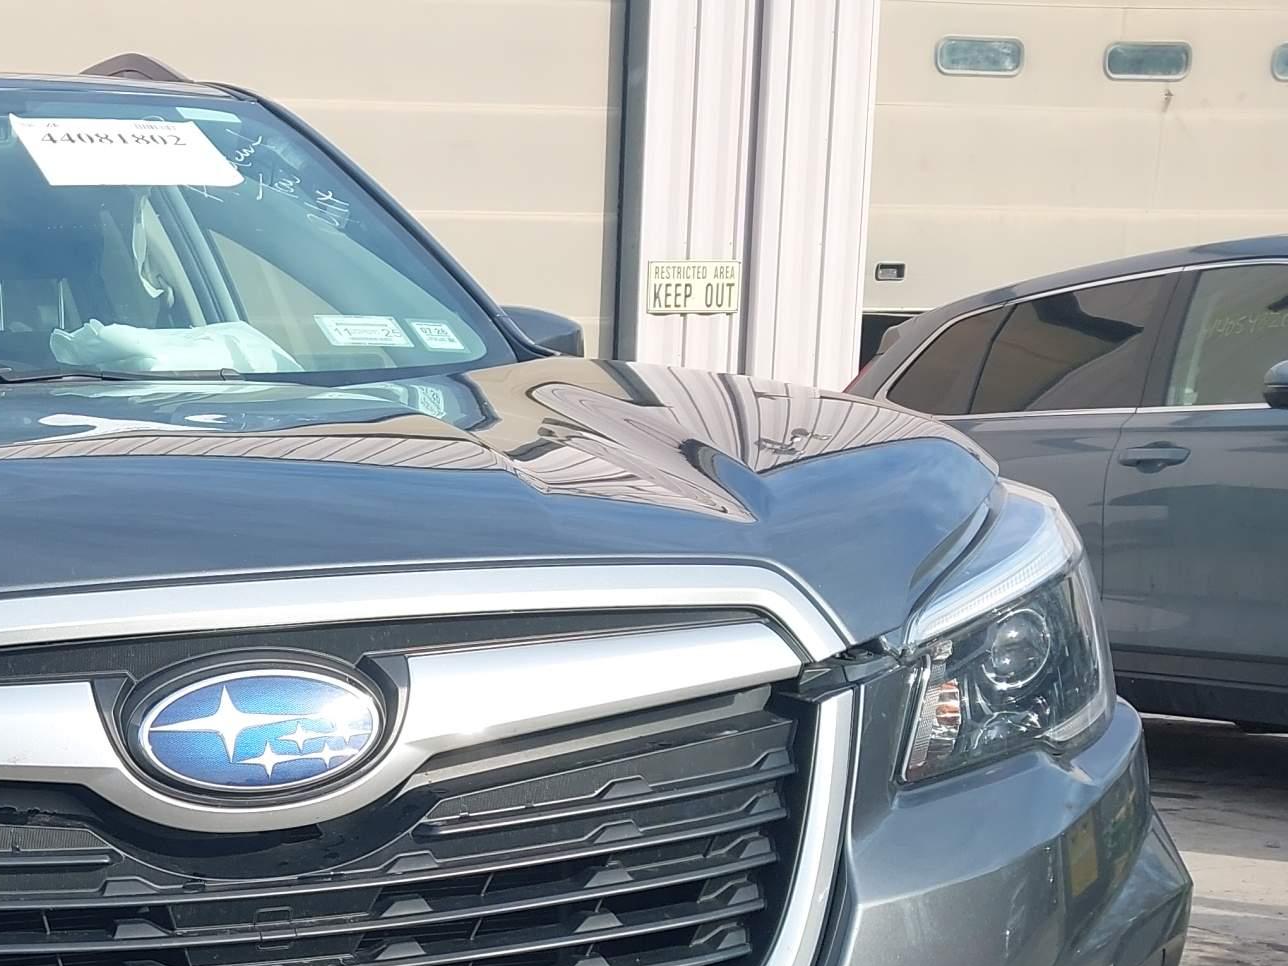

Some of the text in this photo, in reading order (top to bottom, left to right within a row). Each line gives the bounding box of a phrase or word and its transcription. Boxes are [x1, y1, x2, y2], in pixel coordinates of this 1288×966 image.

[41, 132, 187, 146] 44081802
[654, 265, 736, 280] RESTRICTED AREA
[652, 282, 736, 308] KEEP OUT
